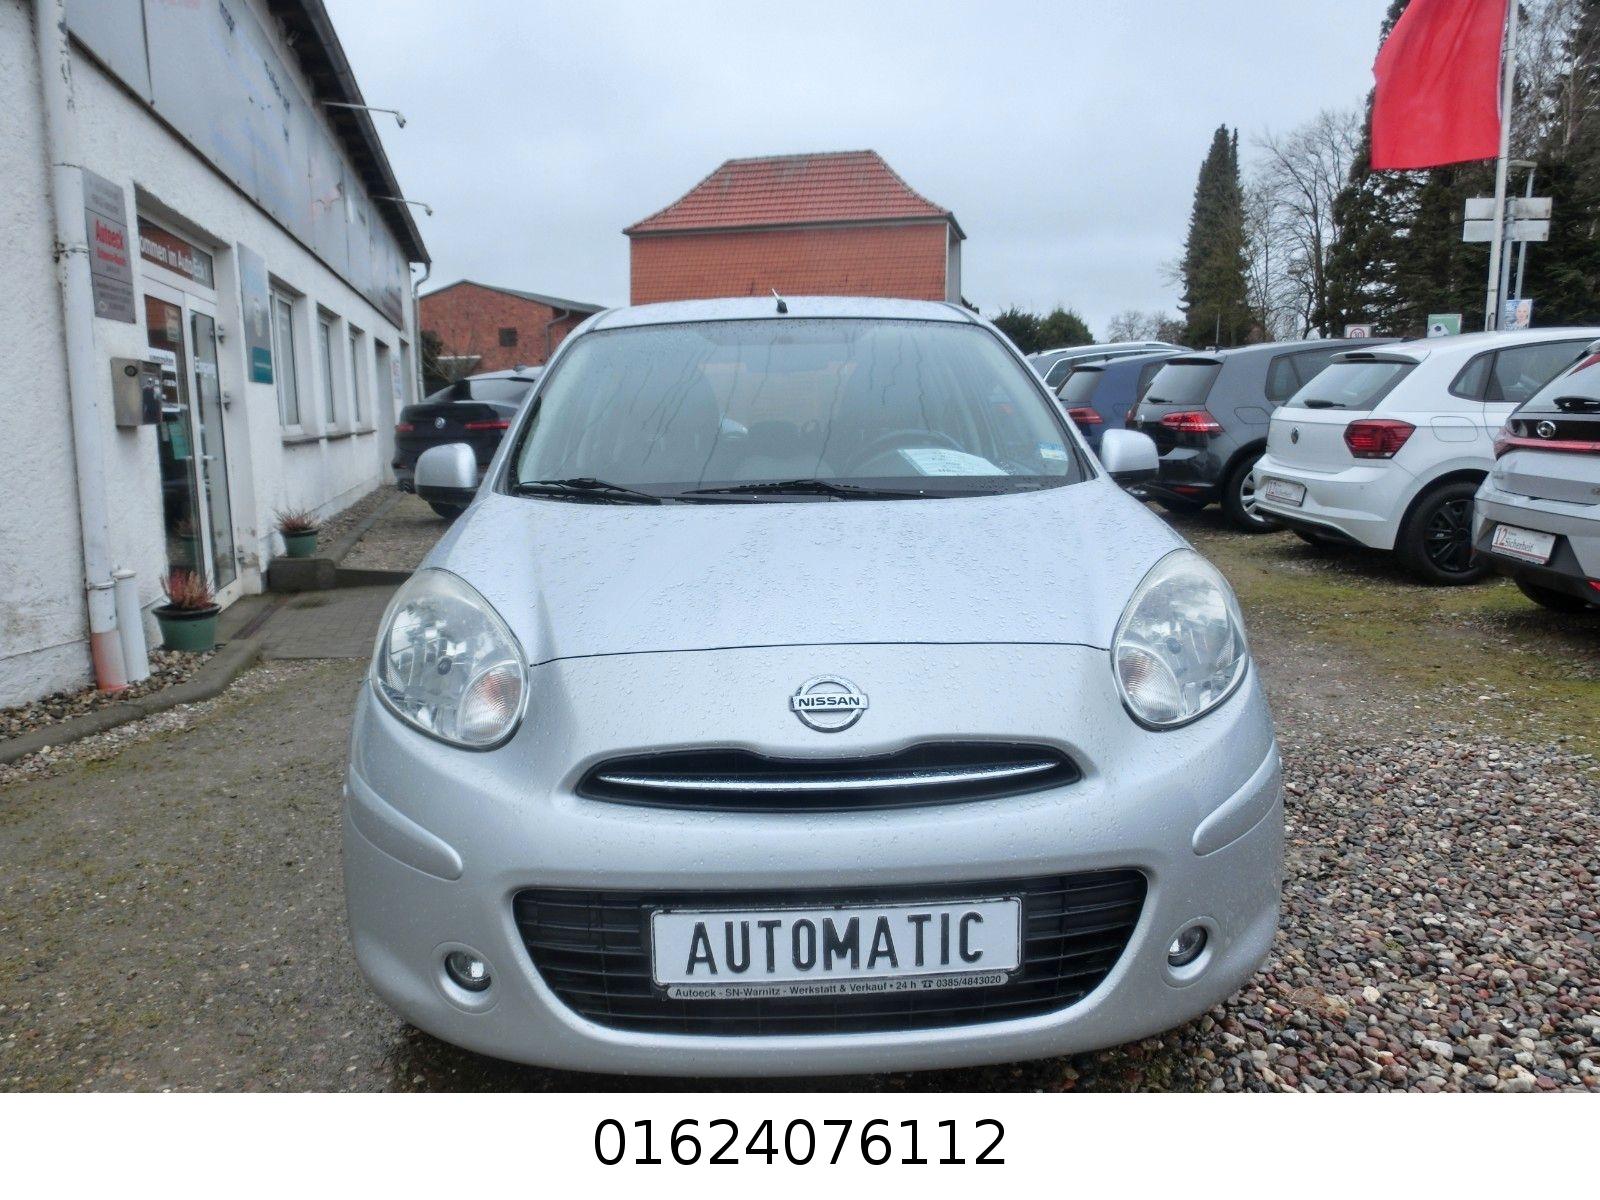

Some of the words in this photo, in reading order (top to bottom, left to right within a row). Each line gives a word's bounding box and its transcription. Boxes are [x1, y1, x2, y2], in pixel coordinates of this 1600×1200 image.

[798, 696, 860, 707] NISSAN
[686, 911, 984, 975] AUTOMATIC
[675, 988, 716, 998] Autoeck
[725, 986, 781, 997] SN-Warnitz
[789, 984, 837, 995] Werkstatt
[839, 984, 847, 993] &
[849, 981, 887, 992] Verkauf
[896, 981, 908, 990] 24
[910, 980, 917, 989] h
[936, 975, 1001, 988] 0385/4843020
